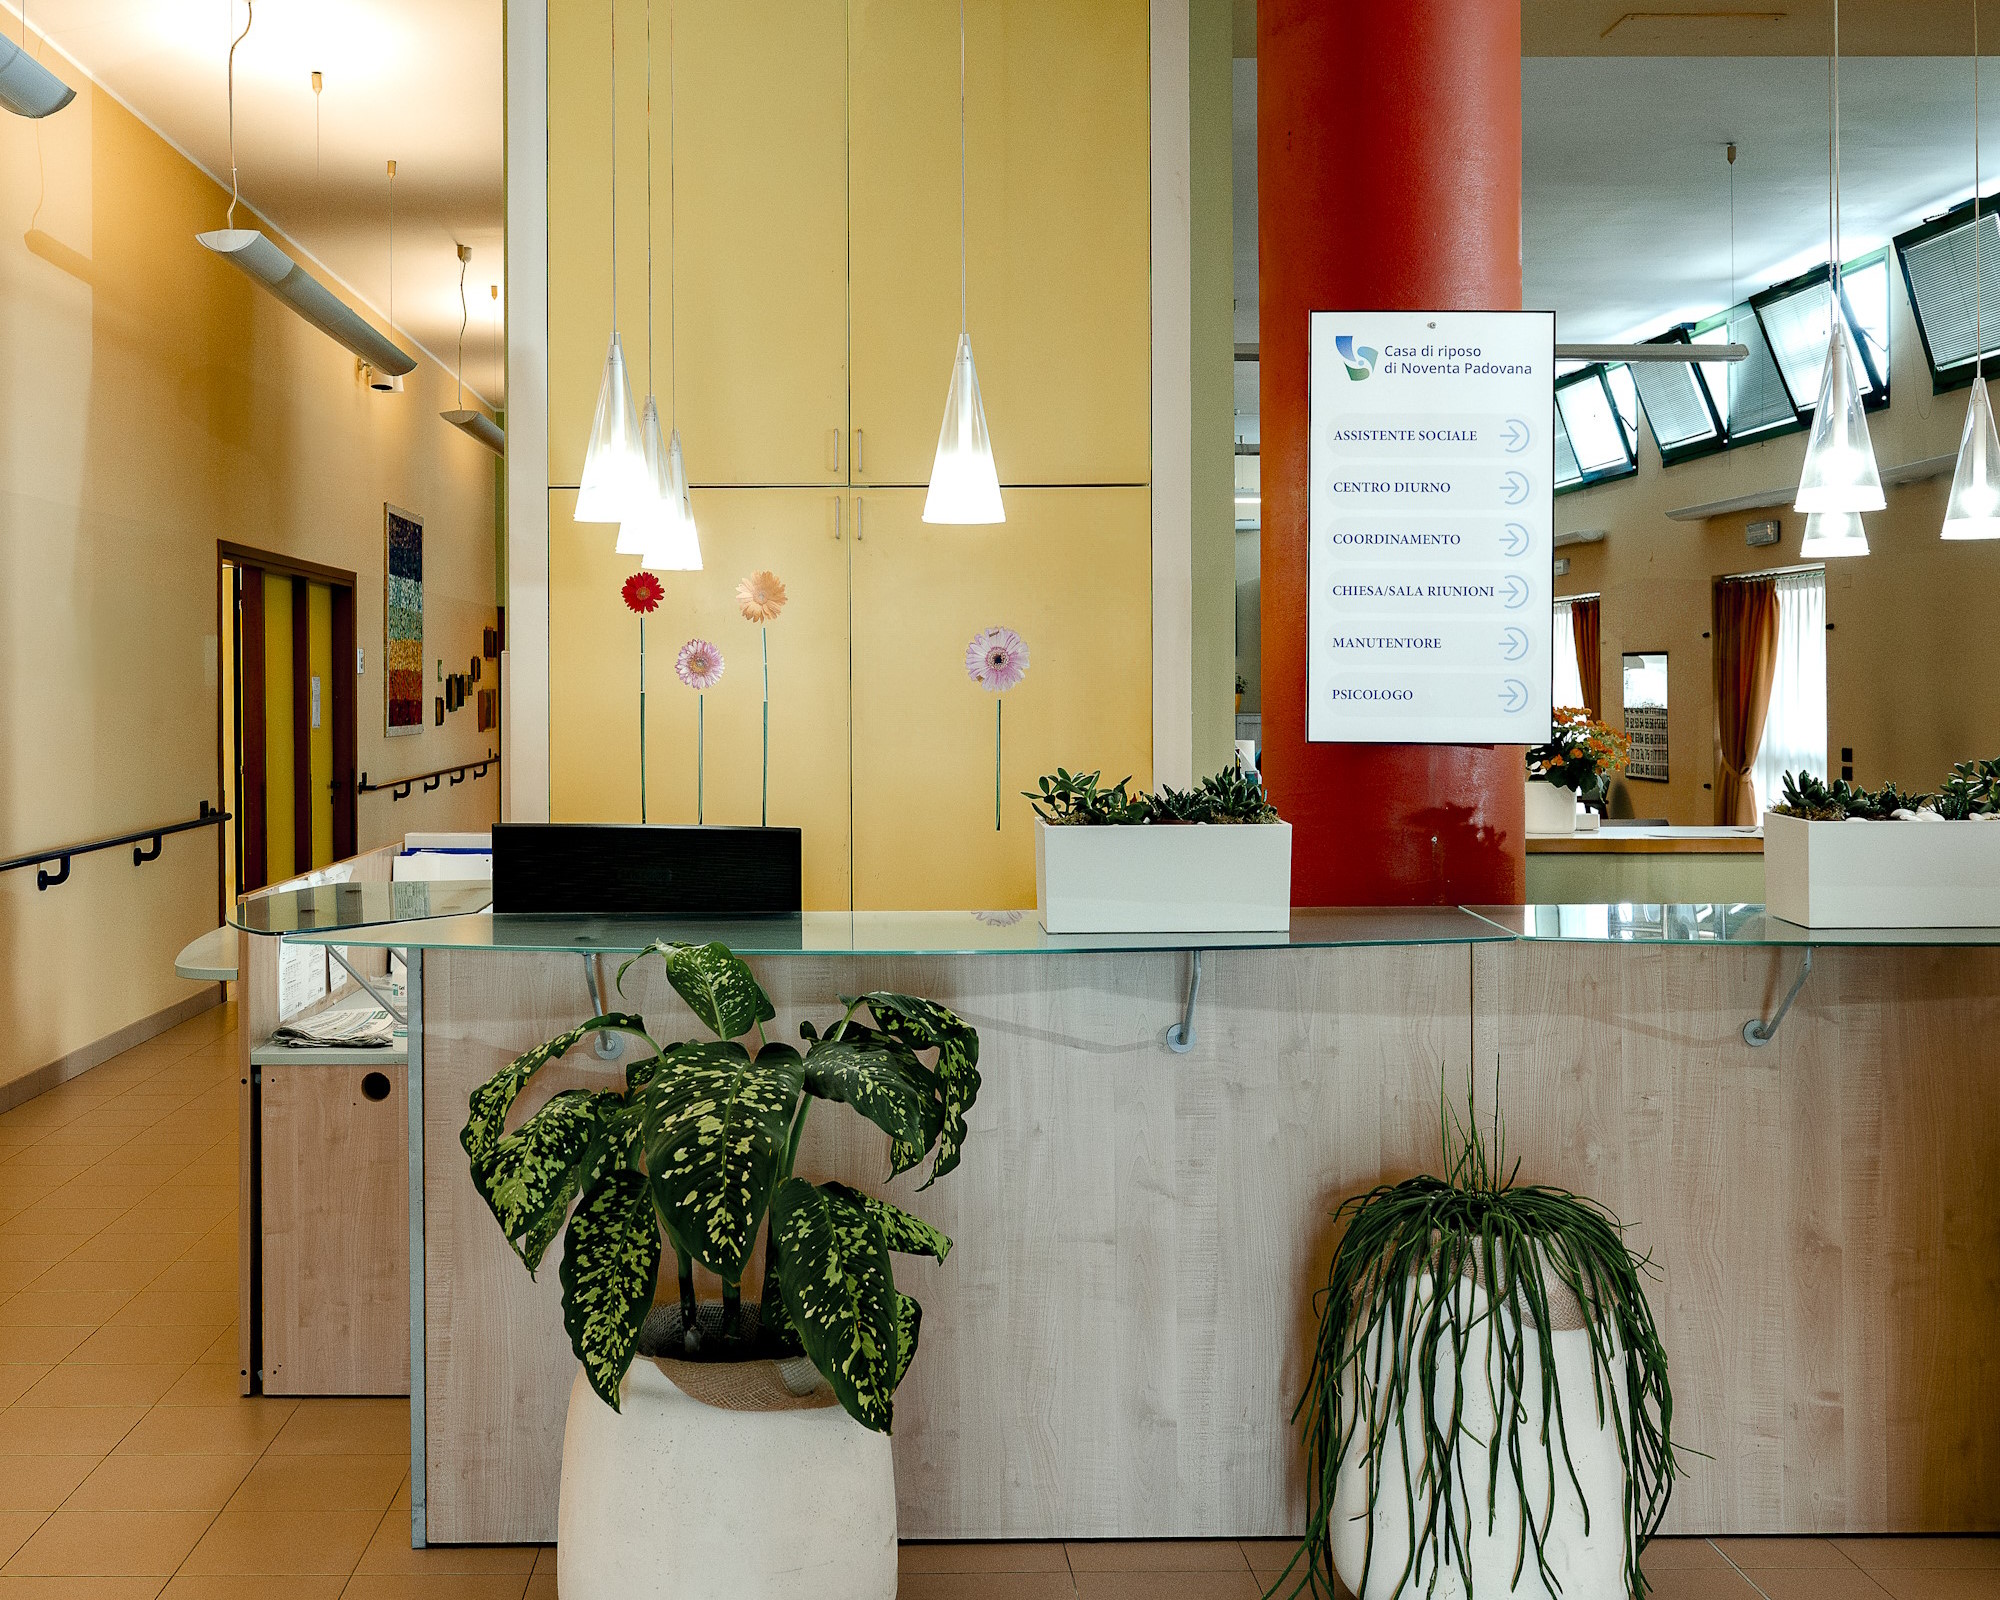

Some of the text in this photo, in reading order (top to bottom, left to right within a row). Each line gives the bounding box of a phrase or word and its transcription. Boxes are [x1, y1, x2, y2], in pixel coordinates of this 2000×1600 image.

[1384, 344, 1482, 361] Casa di riposo
[1384, 361, 1532, 374] di Noventa Padovana
[1333, 430, 1478, 441] ASSISTENTE SOCIALE
[1333, 481, 1451, 493] CENTRO DIURNO
[1332, 533, 1461, 545] COORDINAMENTO
[1332, 585, 1494, 597] CHIESA/SALA RIUNIONI
[1332, 637, 1442, 649] MANUTENTORE
[1332, 689, 1414, 701] PSICOLOGO
